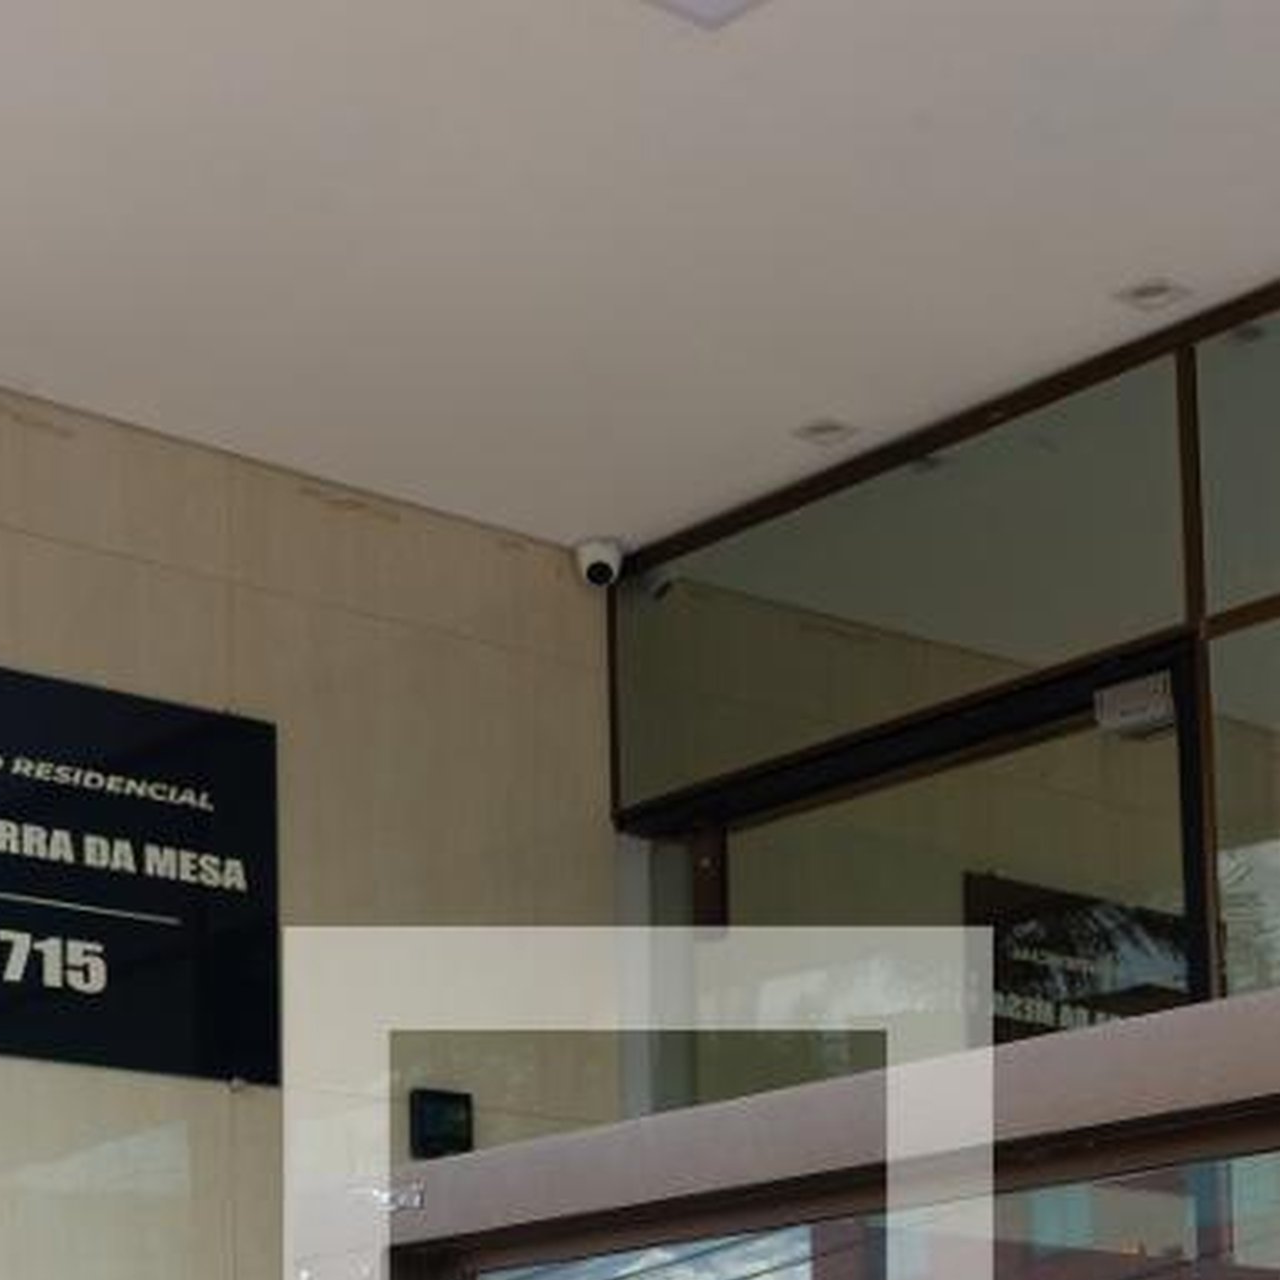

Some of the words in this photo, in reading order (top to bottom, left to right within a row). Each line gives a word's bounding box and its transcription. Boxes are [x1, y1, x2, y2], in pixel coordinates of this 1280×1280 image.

[11, 757, 214, 812] RESIDENCIAL
[83, 834, 137, 874] DA
[144, 844, 248, 892] MESA
